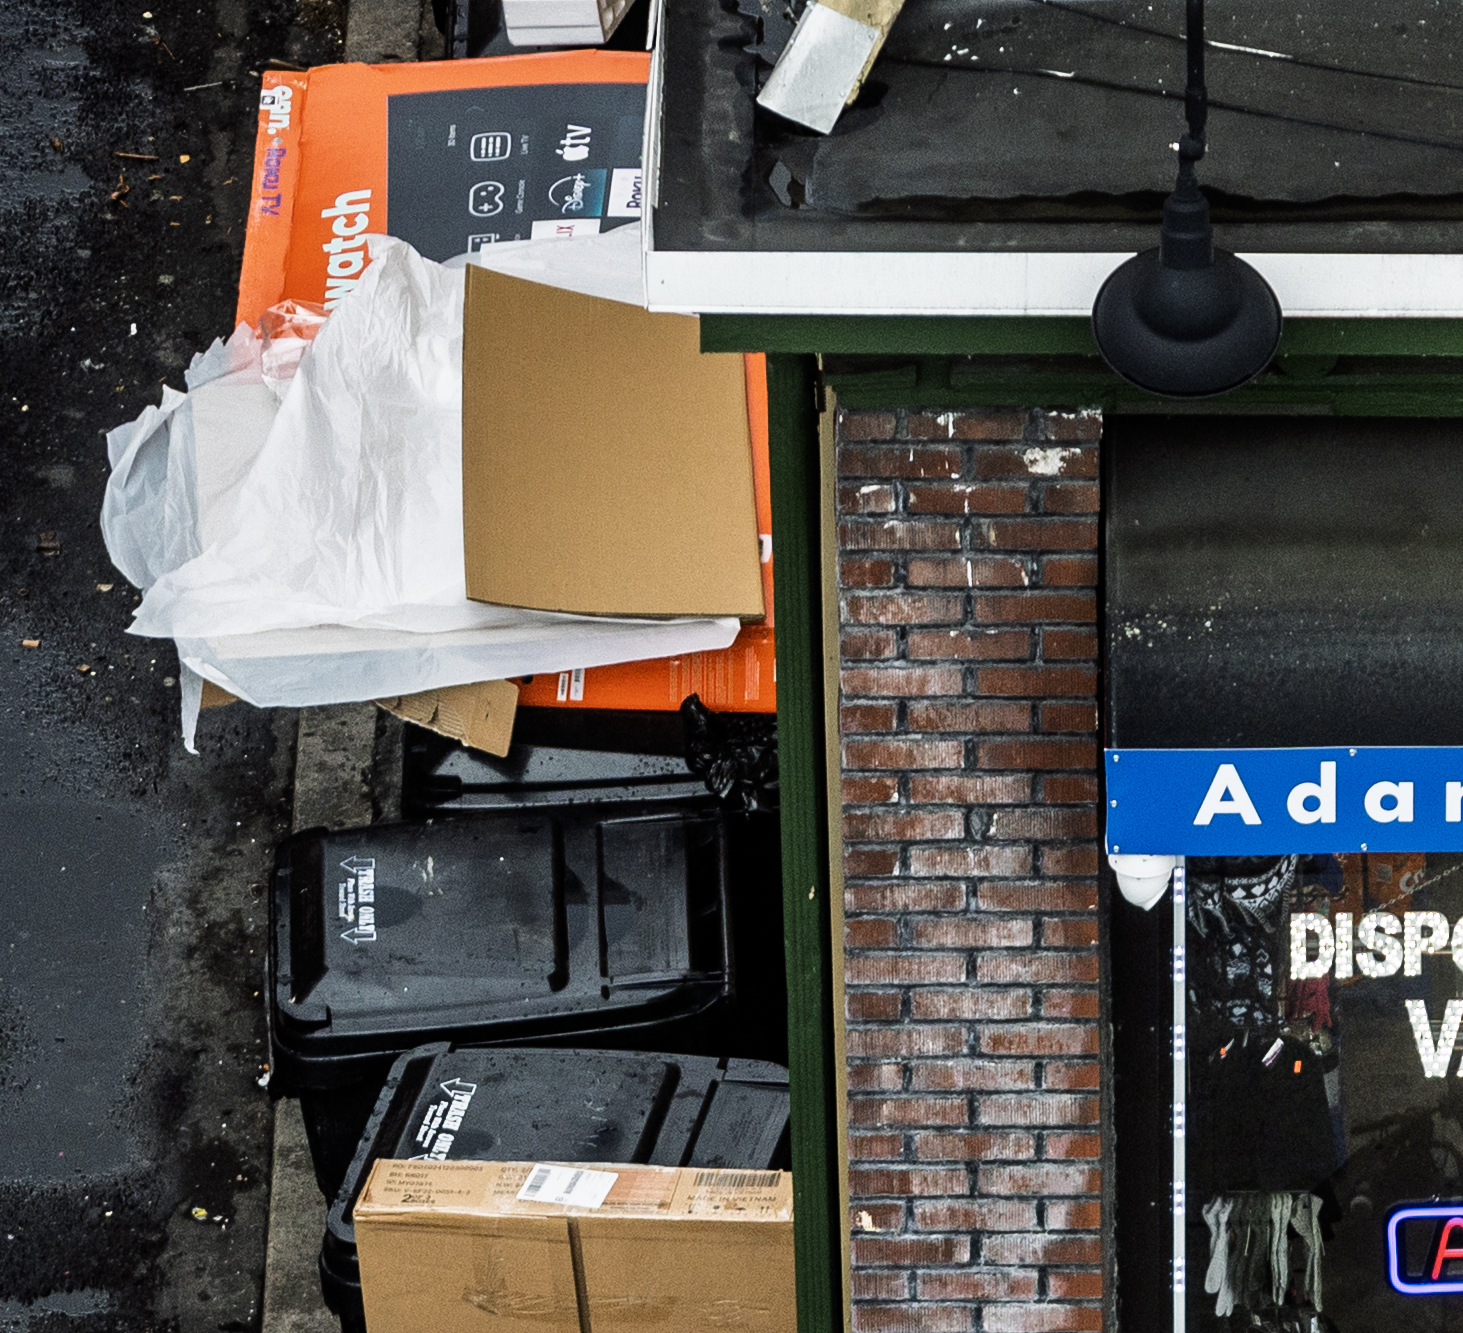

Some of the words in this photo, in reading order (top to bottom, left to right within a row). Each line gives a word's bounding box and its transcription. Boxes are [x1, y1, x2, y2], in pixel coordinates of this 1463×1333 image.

[261, 193, 282, 215] TV
[358, 868, 375, 902] TRASH
[358, 905, 375, 931] ONLY
[442, 1094, 472, 1131] TRASH
[430, 1132, 455, 1161] ONLY
